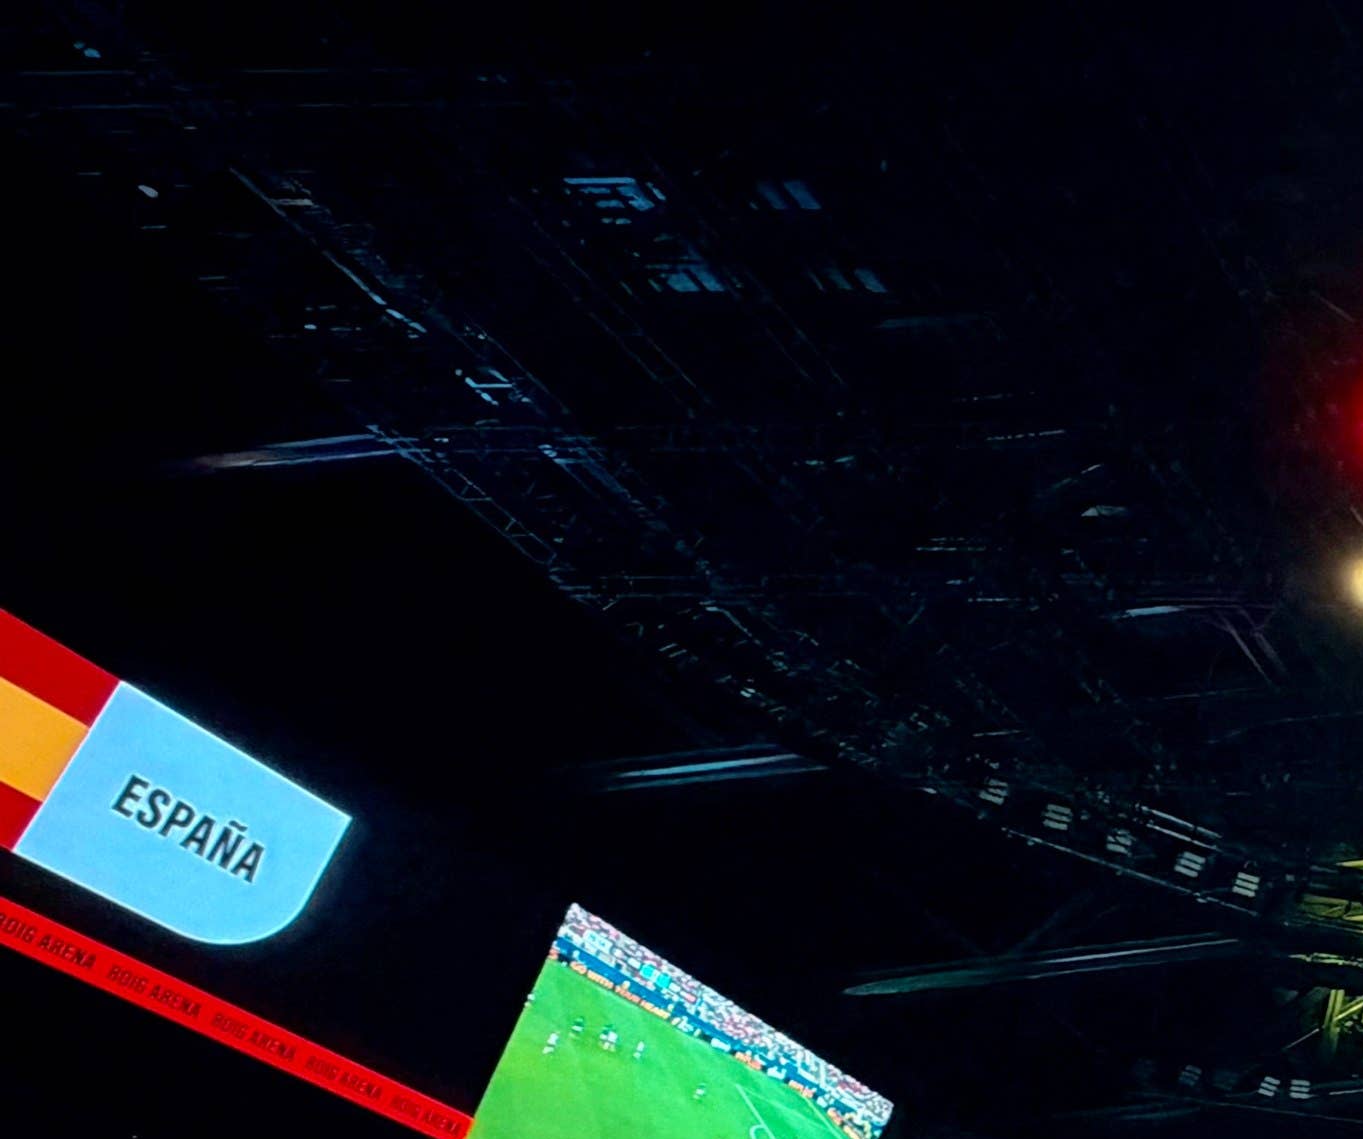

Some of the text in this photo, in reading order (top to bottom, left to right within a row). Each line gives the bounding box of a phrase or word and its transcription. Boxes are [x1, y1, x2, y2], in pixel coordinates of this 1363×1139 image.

[111, 774, 265, 884] ESPAÑA
[37, 934, 97, 970] ARENA
[148, 984, 201, 1018] ARENA
